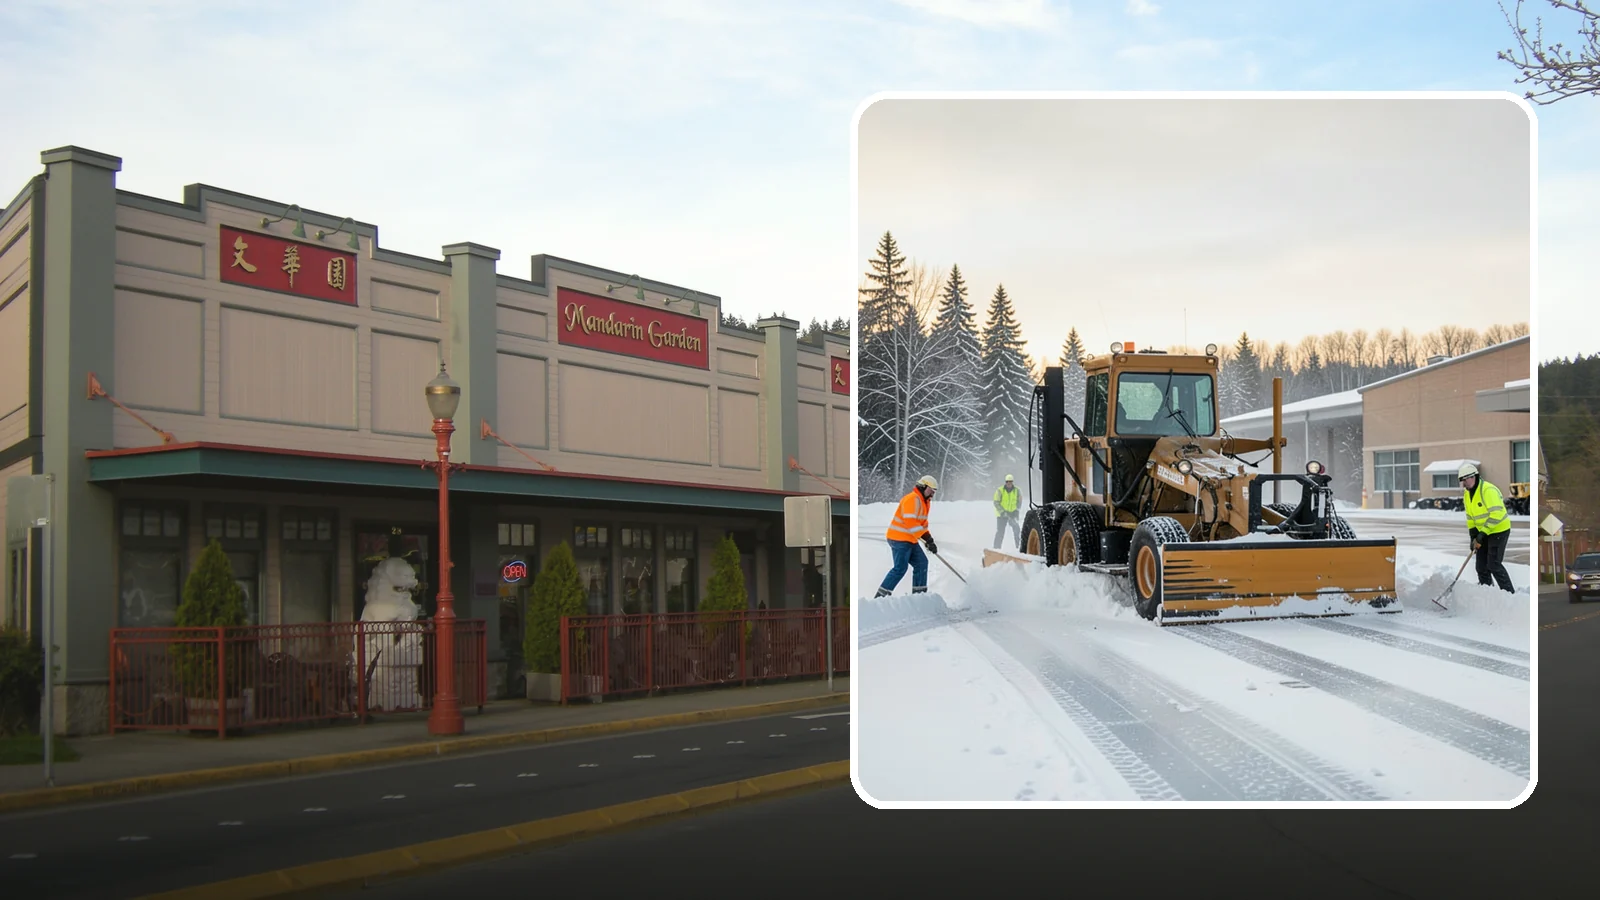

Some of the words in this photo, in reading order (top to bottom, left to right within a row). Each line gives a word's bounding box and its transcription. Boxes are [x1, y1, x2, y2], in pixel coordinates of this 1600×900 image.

[231, 236, 346, 291] 文華園
[564, 302, 644, 341] Mandarin
[648, 320, 701, 352] Garden
[503, 565, 527, 578] OPEN
